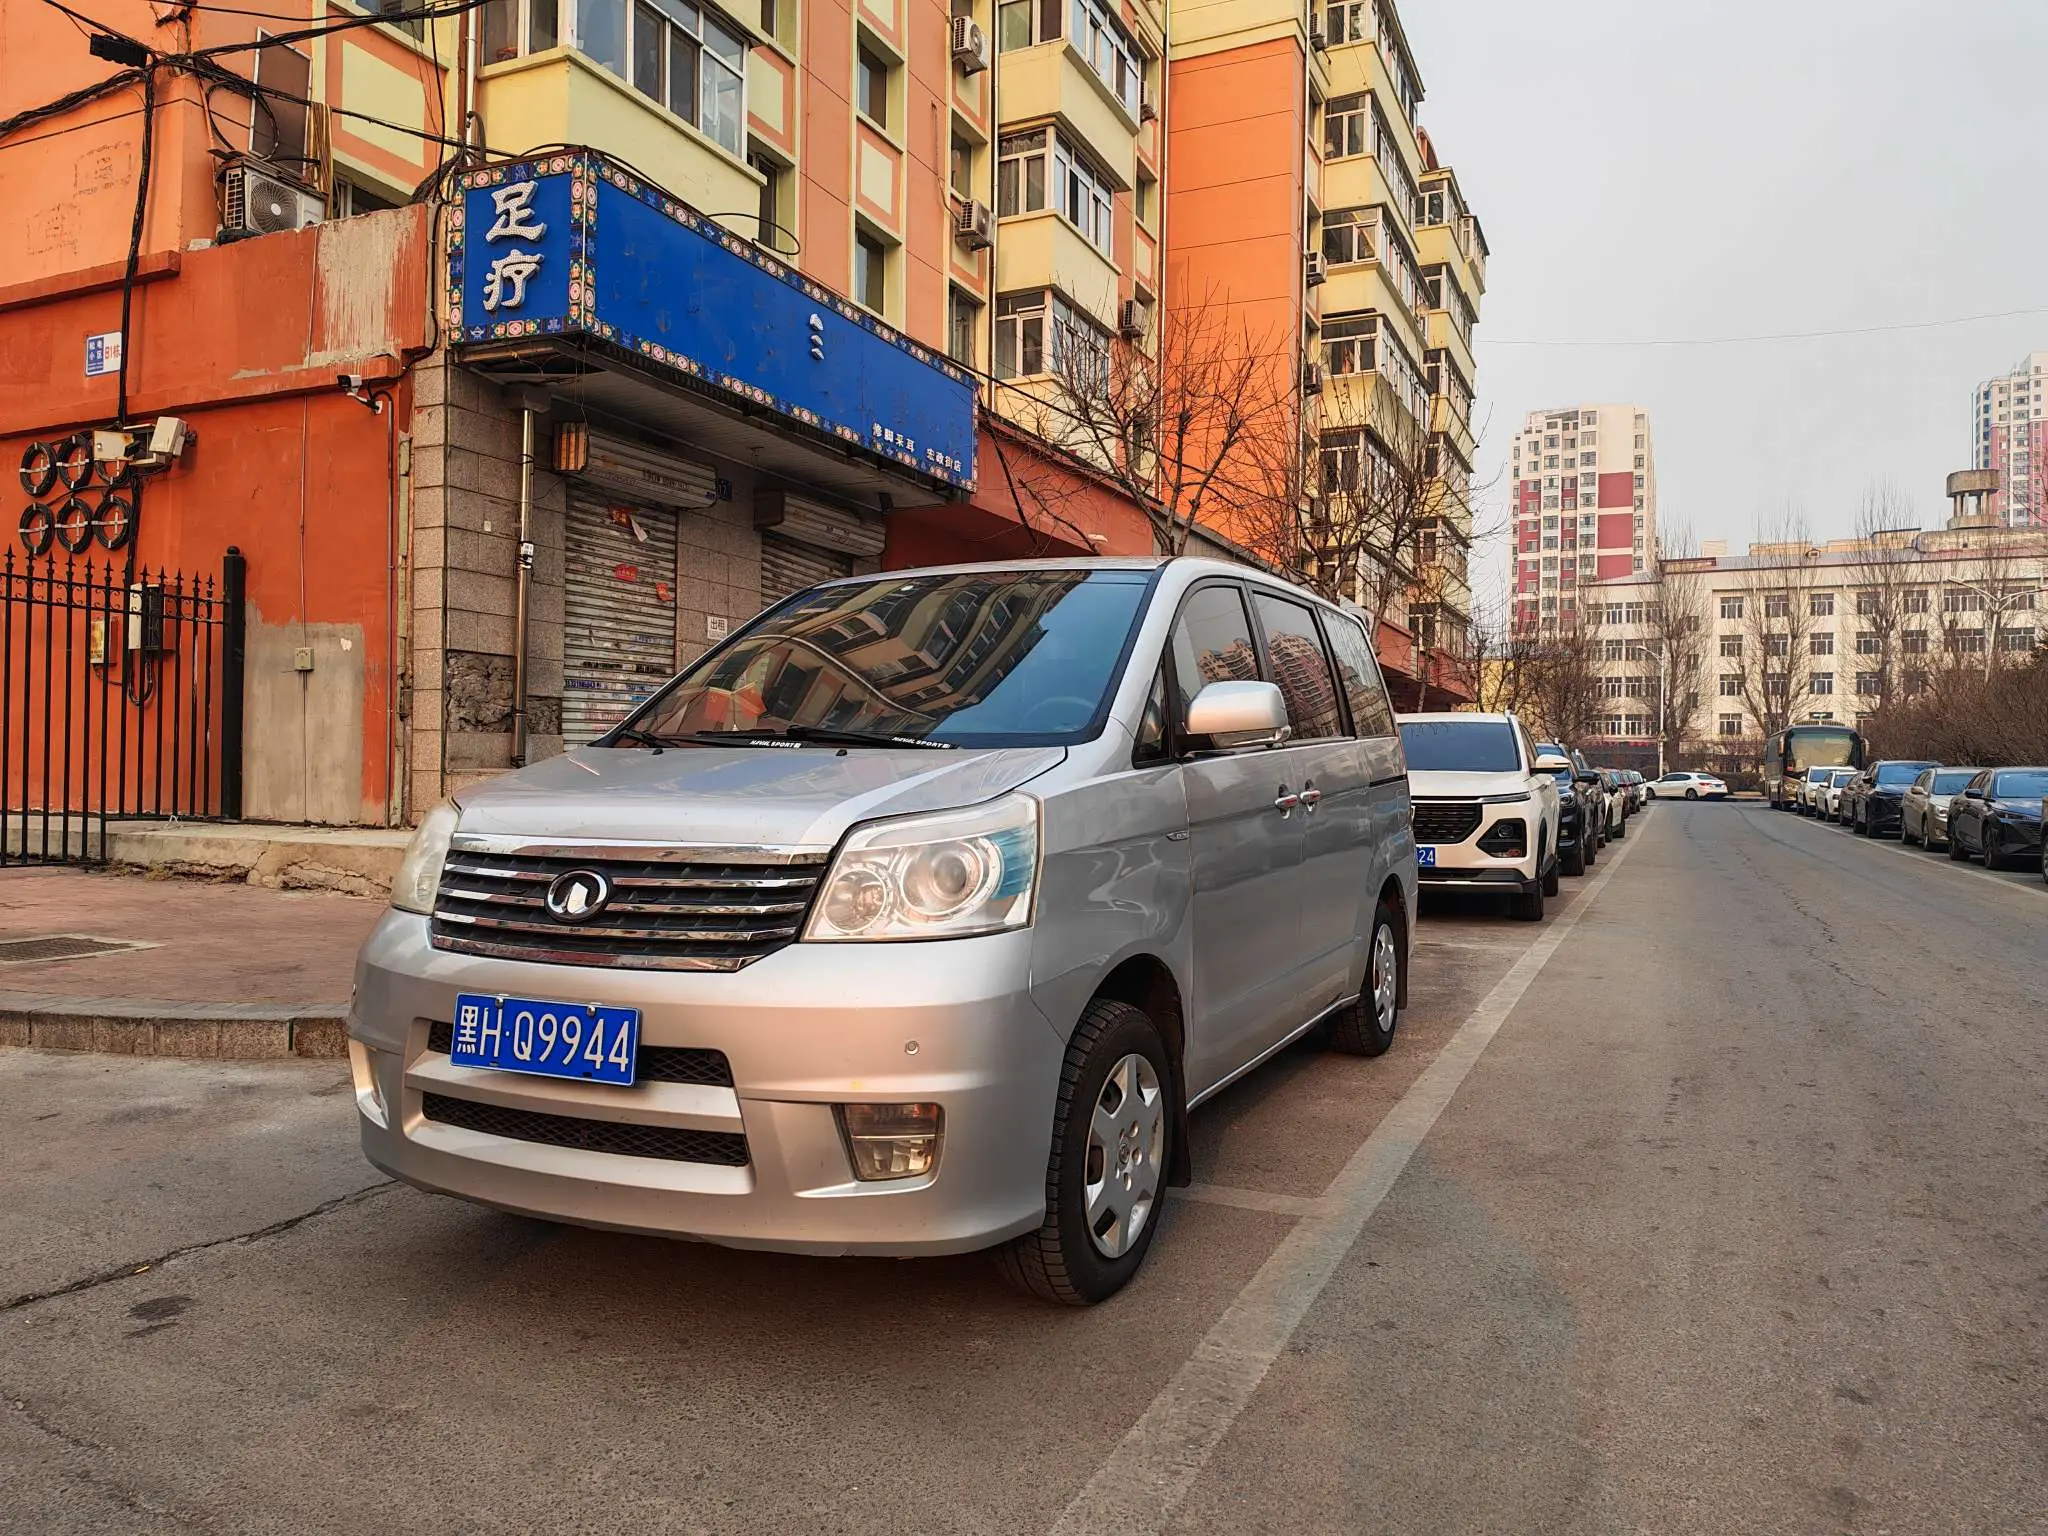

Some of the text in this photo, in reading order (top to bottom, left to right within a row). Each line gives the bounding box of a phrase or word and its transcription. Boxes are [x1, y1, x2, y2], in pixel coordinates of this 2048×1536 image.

[483, 180, 548, 312] 足疗
[873, 422, 915, 453] 修脚采耳
[710, 617, 726, 631] 出租
[456, 1004, 630, 1073] 黑H·Q9944
